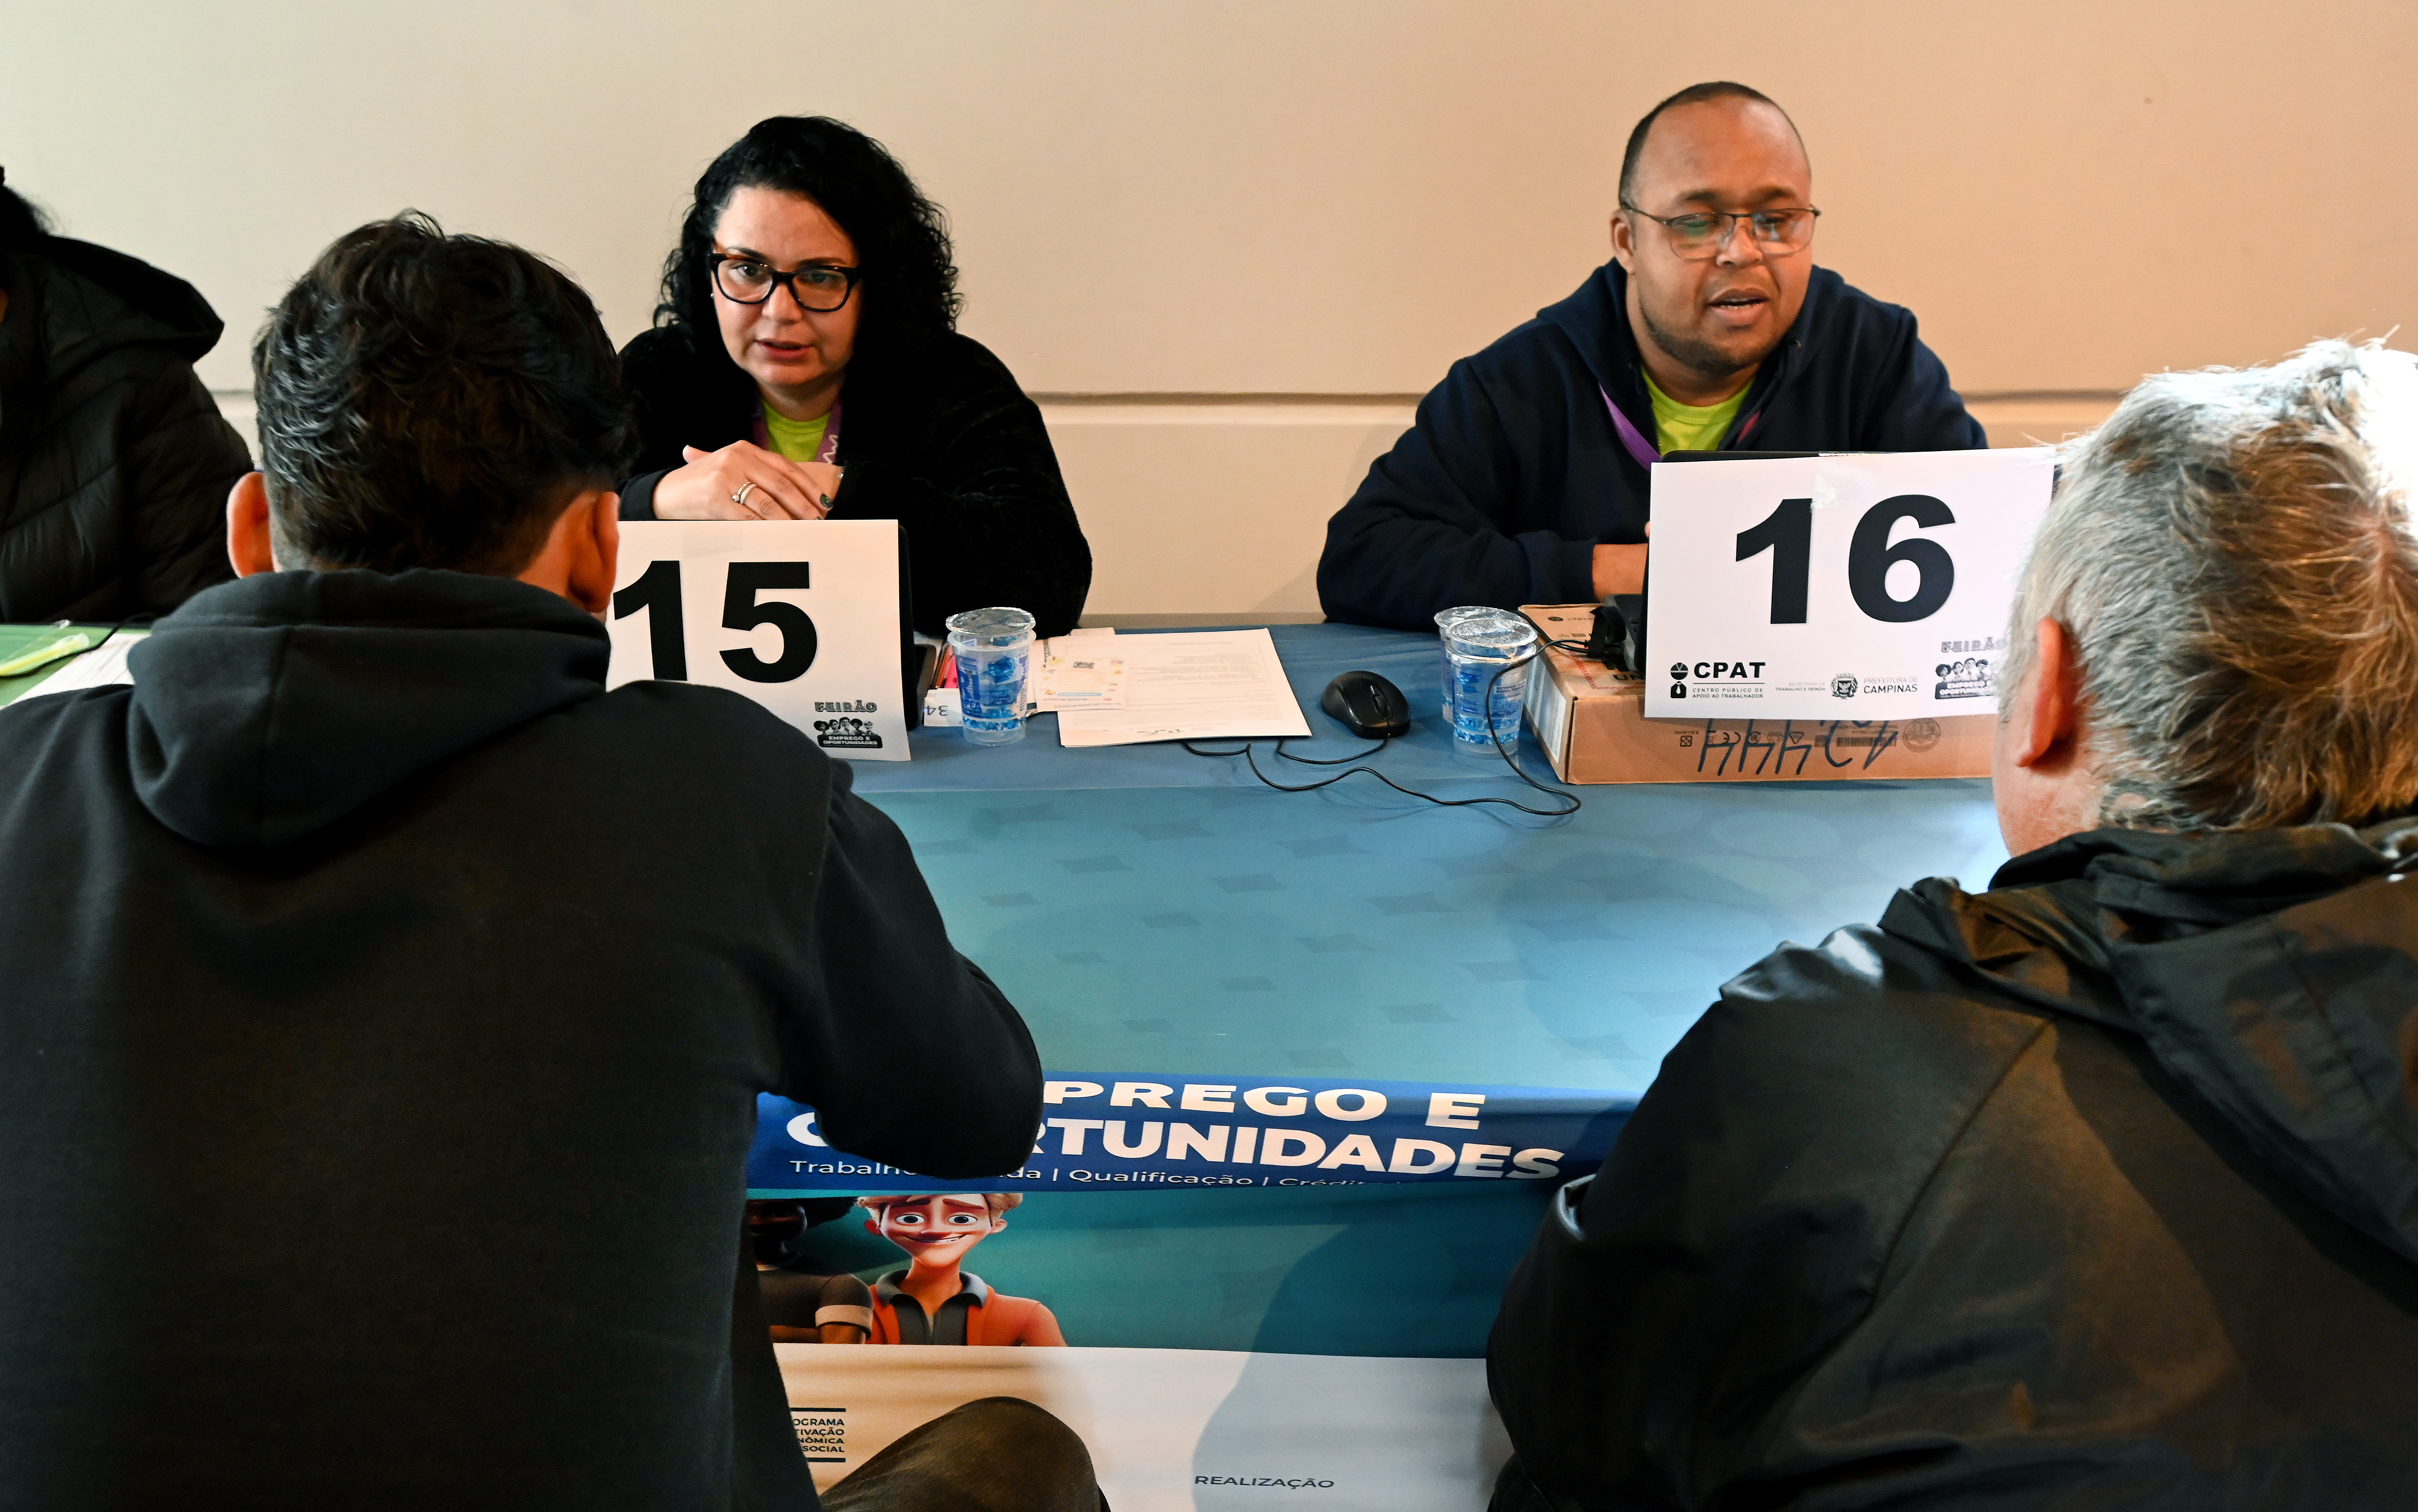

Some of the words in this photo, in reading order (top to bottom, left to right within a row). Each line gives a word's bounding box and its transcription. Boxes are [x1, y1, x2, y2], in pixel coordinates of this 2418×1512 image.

[1736, 495, 1956, 624] 16
[613, 560, 818, 683] 15
[1694, 662, 1766, 679] CPAT
[1864, 684, 1918, 694] CAMPINAS
[815, 700, 878, 712] FEIRÃO
[1043, 1081, 1387, 1121] PREGO
[1425, 1092, 1486, 1130] E
[1069, 1169, 1253, 1186] Qualificação
[1195, 1476, 1335, 1489] REALIZAÇÃO
